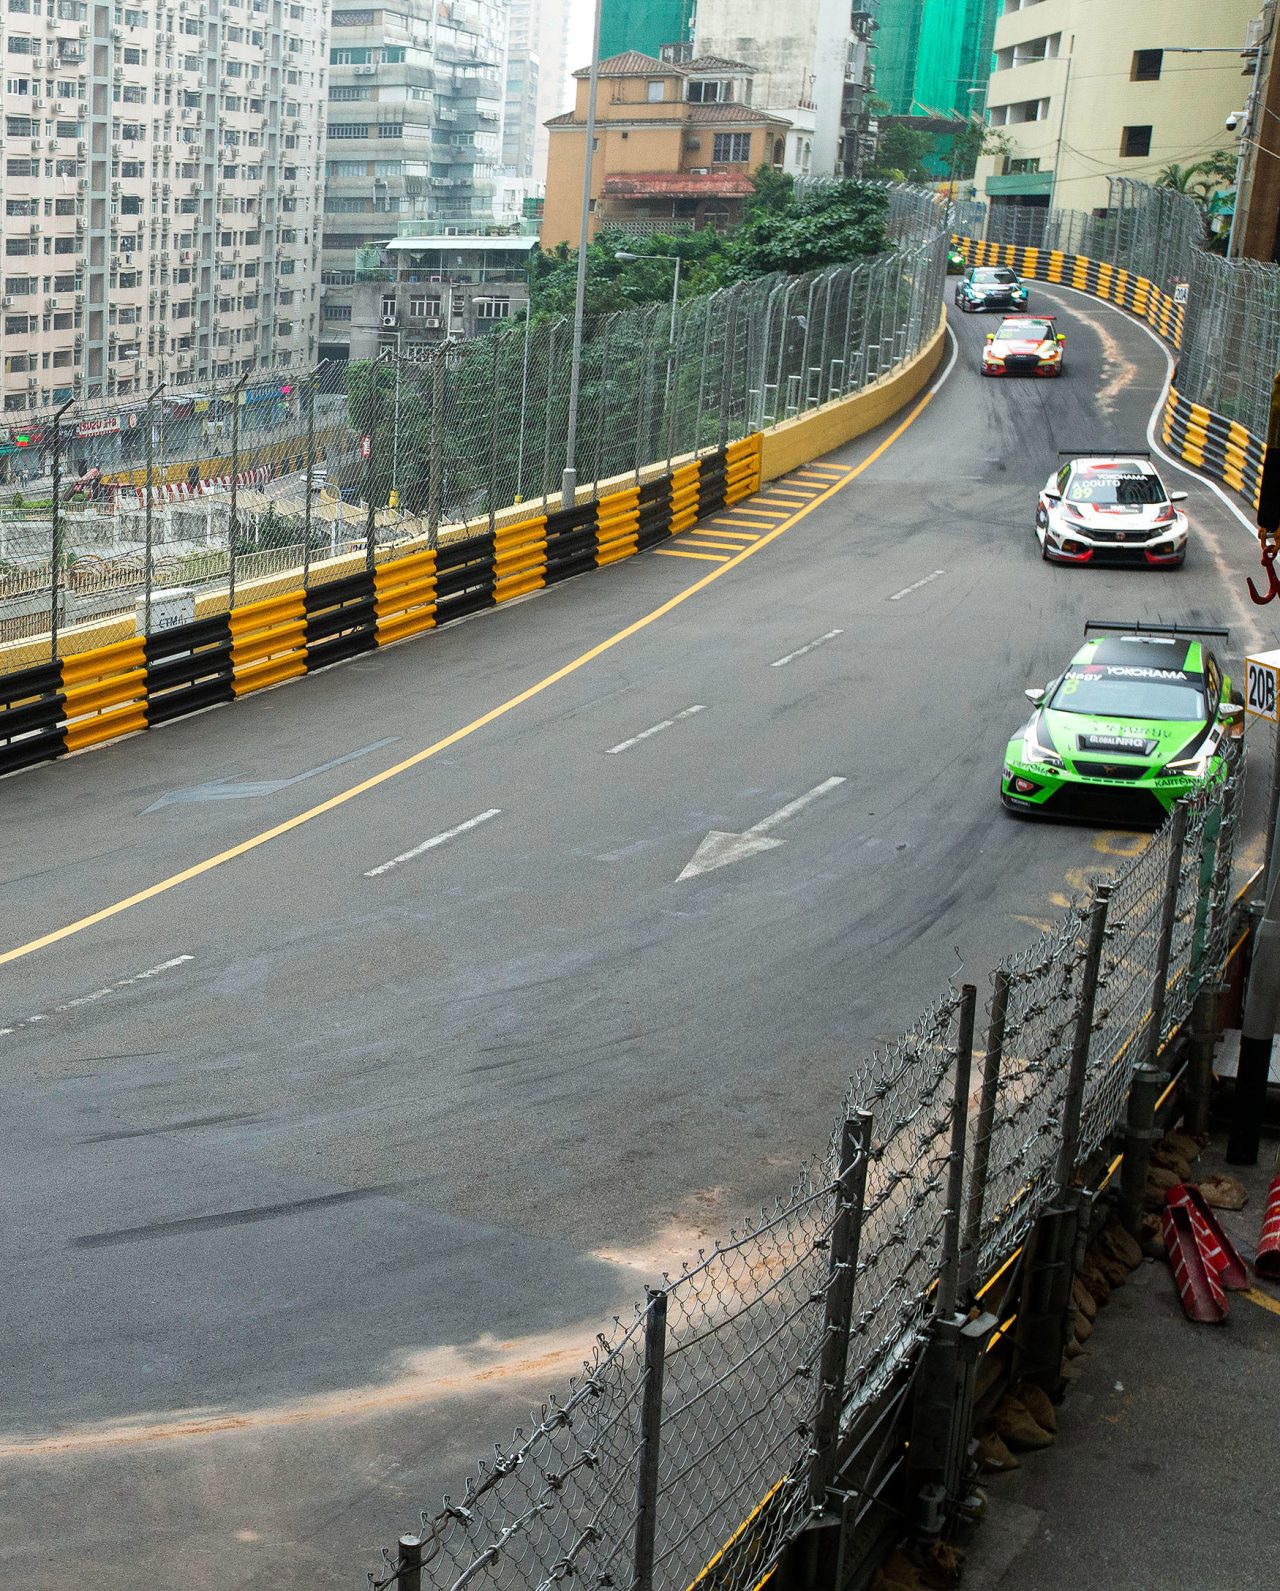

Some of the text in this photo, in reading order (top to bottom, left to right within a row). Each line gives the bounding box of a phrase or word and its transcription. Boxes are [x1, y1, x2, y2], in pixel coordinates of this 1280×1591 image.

[1072, 487, 1093, 499] 89
[1064, 671, 1102, 681] Nagy
[1106, 666, 1188, 680] YOKOHAMA
[1062, 678, 1080, 695] 8
[1249, 665, 1275, 713] 20B
